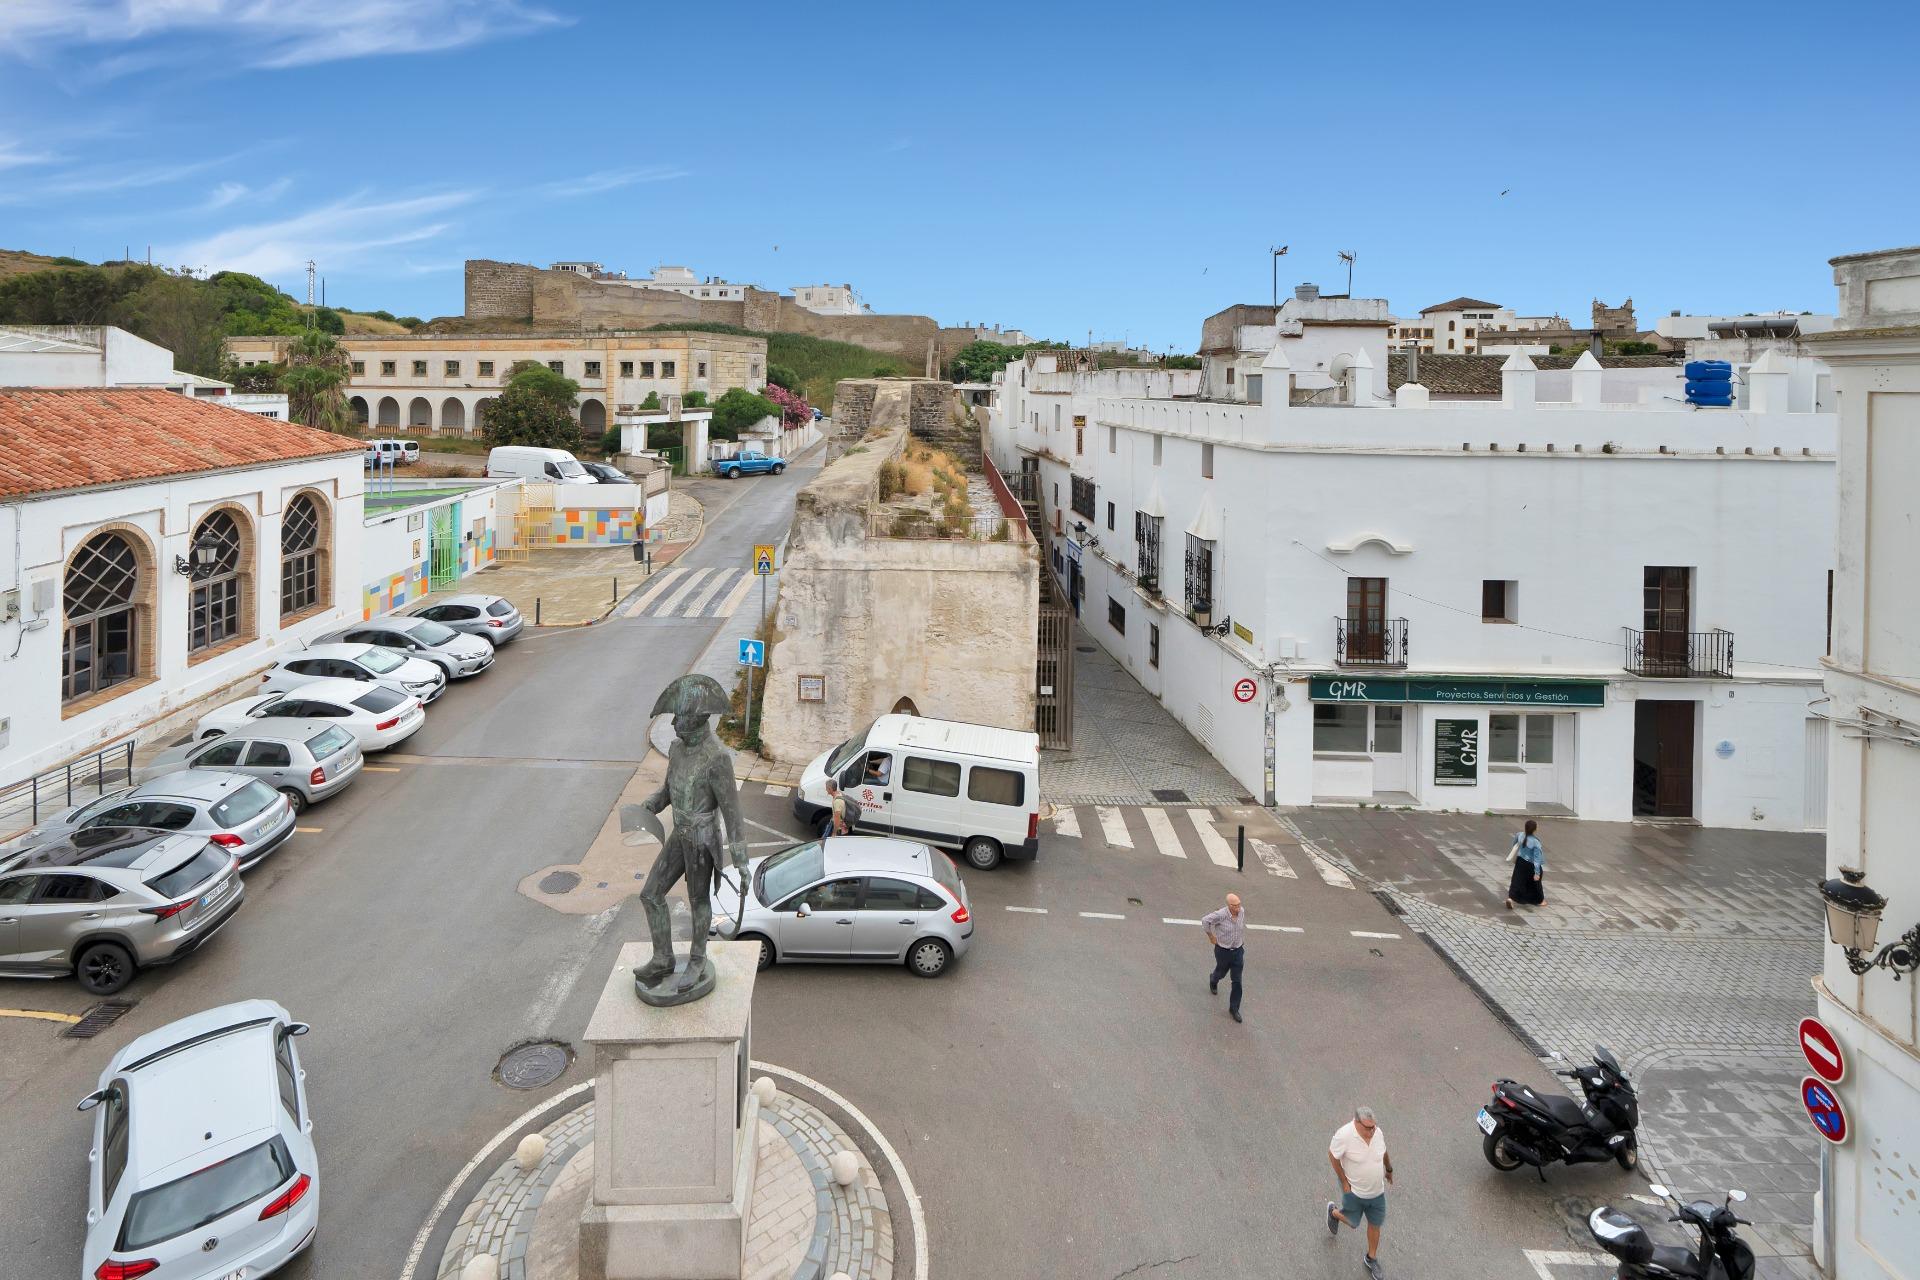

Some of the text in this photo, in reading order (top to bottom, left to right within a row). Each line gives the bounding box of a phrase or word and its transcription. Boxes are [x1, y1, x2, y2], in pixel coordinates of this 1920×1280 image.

[1329, 681, 1368, 701] GMR
[1483, 691, 1524, 700] Servicios
[1526, 693, 1532, 701] y
[1534, 692, 1569, 701] Gestión
[1460, 729, 1477, 766] GMR
[857, 801, 883, 809] aritas
